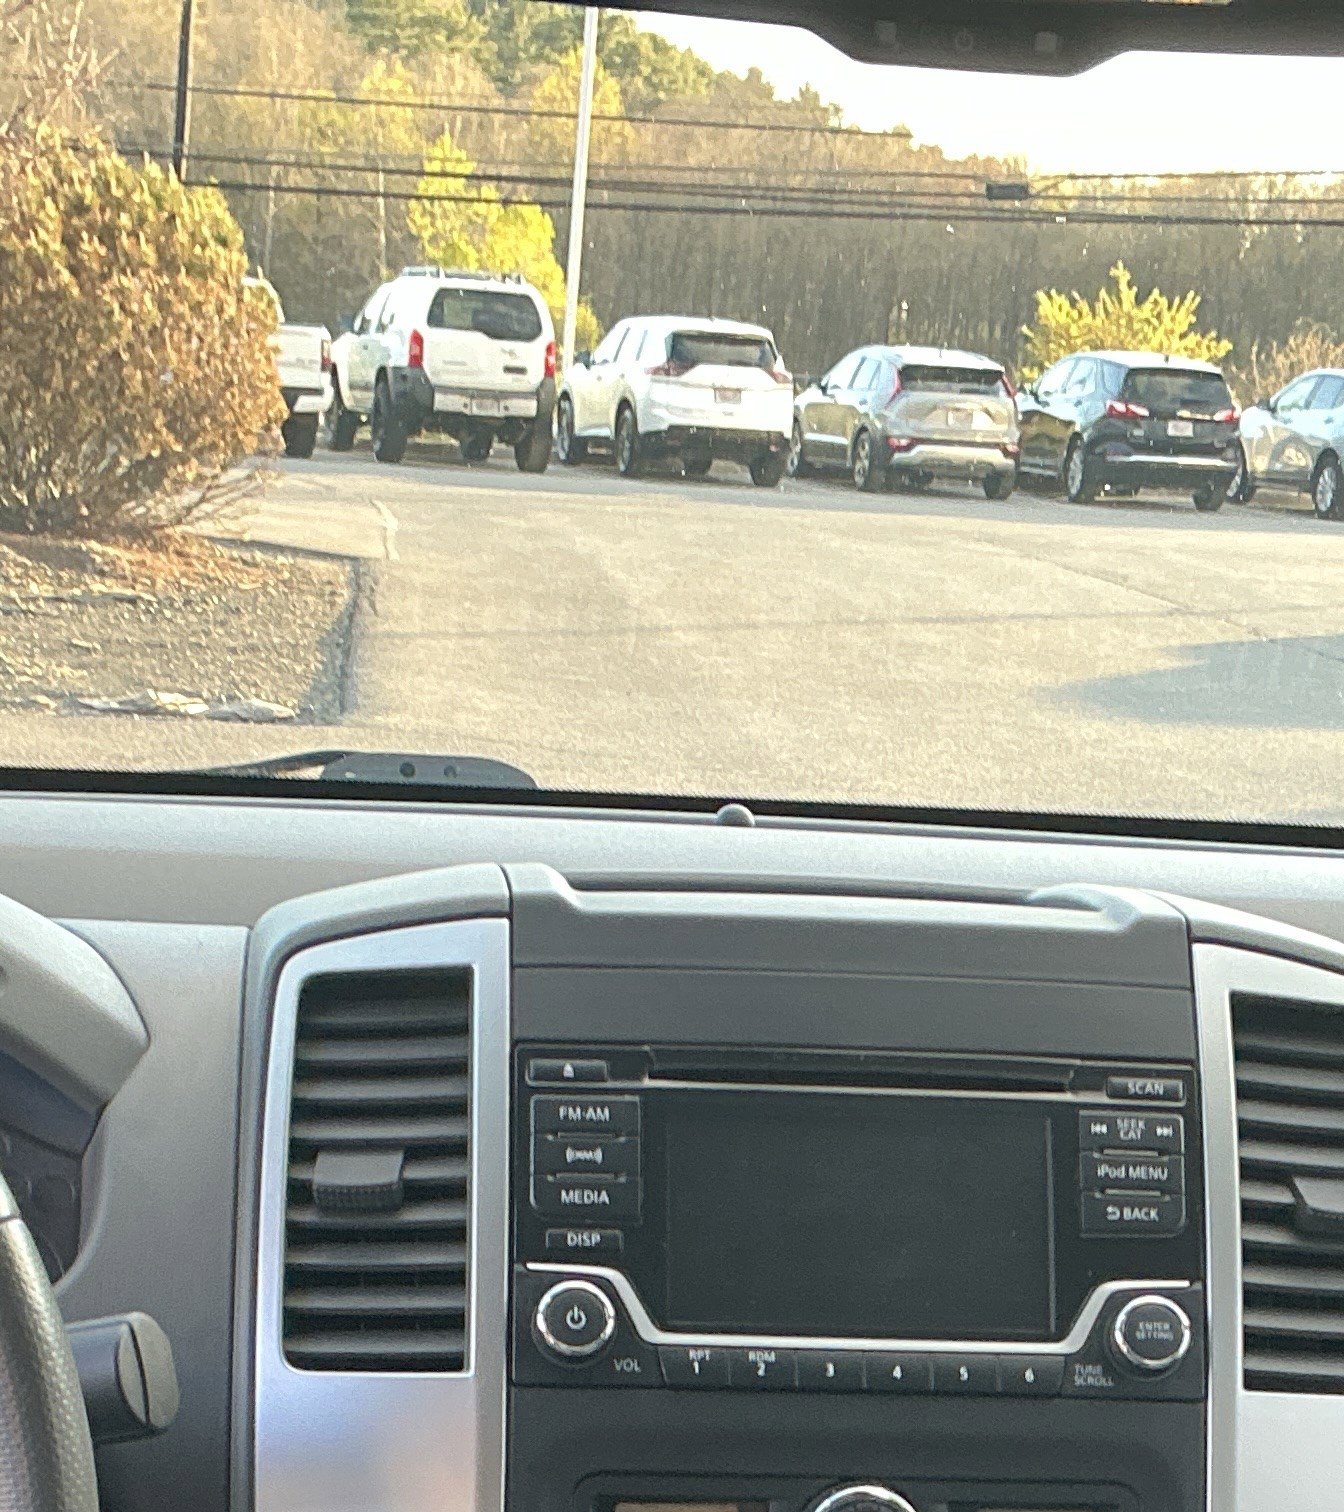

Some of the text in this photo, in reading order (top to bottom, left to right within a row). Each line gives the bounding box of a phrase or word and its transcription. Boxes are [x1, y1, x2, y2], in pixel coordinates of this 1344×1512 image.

[1127, 1081, 1164, 1096] SCAN
[1097, 1163, 1169, 1181] iPod MENU
[560, 1188, 610, 1206] MEDIA
[1123, 1206, 1159, 1221] BACK
[566, 1231, 602, 1248] DISP
[748, 1350, 776, 1363] RDM
[613, 1357, 642, 1373] VOL
[825, 1361, 835, 1378] 3
[892, 1364, 903, 1380] 4
[1024, 1366, 1035, 1384] 6
